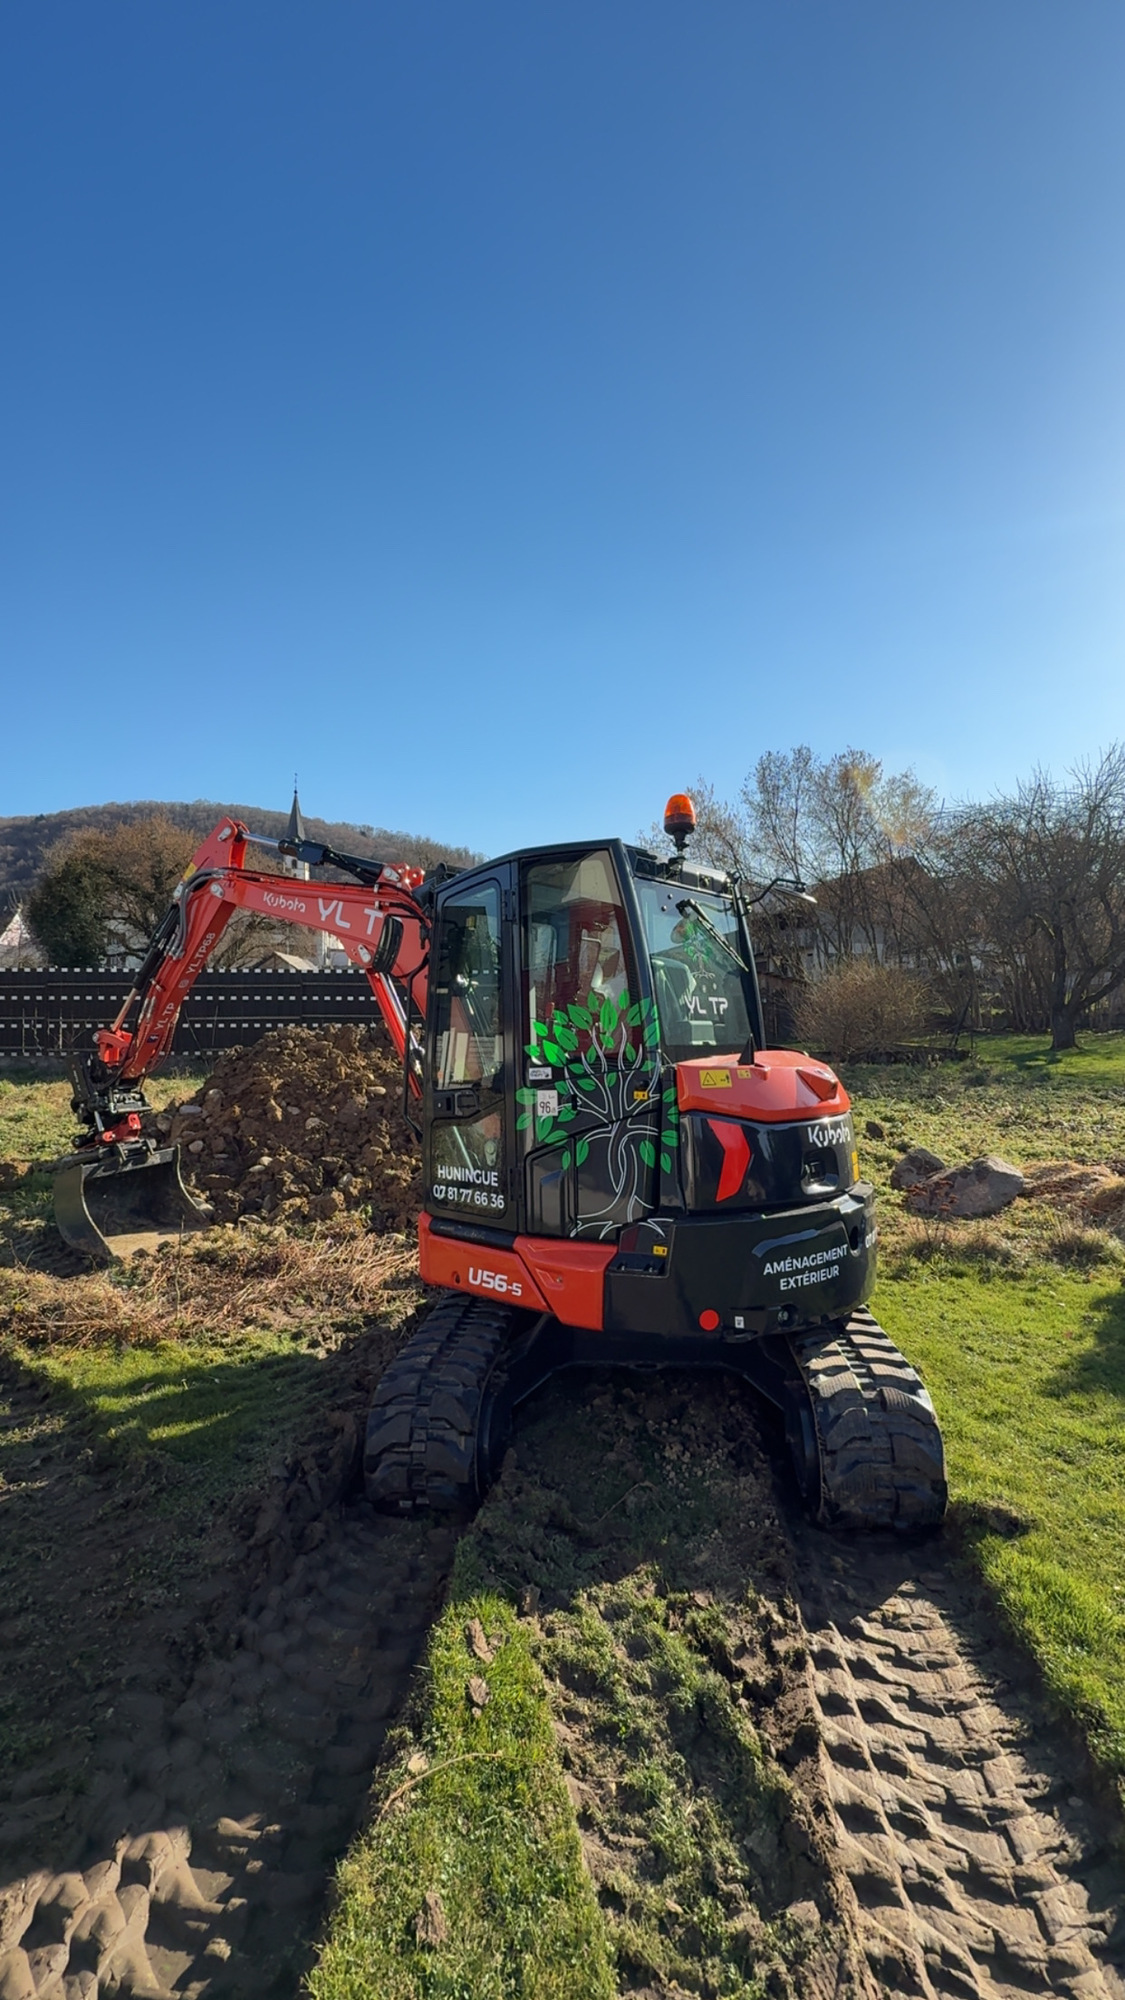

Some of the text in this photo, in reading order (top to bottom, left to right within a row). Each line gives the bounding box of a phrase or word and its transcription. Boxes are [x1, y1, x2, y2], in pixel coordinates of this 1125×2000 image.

[263, 892, 305, 912] Kubota
[318, 897, 350, 929] YL
[684, 996, 728, 1015] YL TP
[539, 1101, 551, 1114] 96
[807, 1124, 851, 1148] Kubota
[437, 1164, 499, 1187] HUNINGUE
[433, 1184, 505, 1209] 07 81 77 66 36
[763, 1244, 849, 1275] AMÉNAGEMENT
[780, 1265, 840, 1291] EXTÉRIEUR
